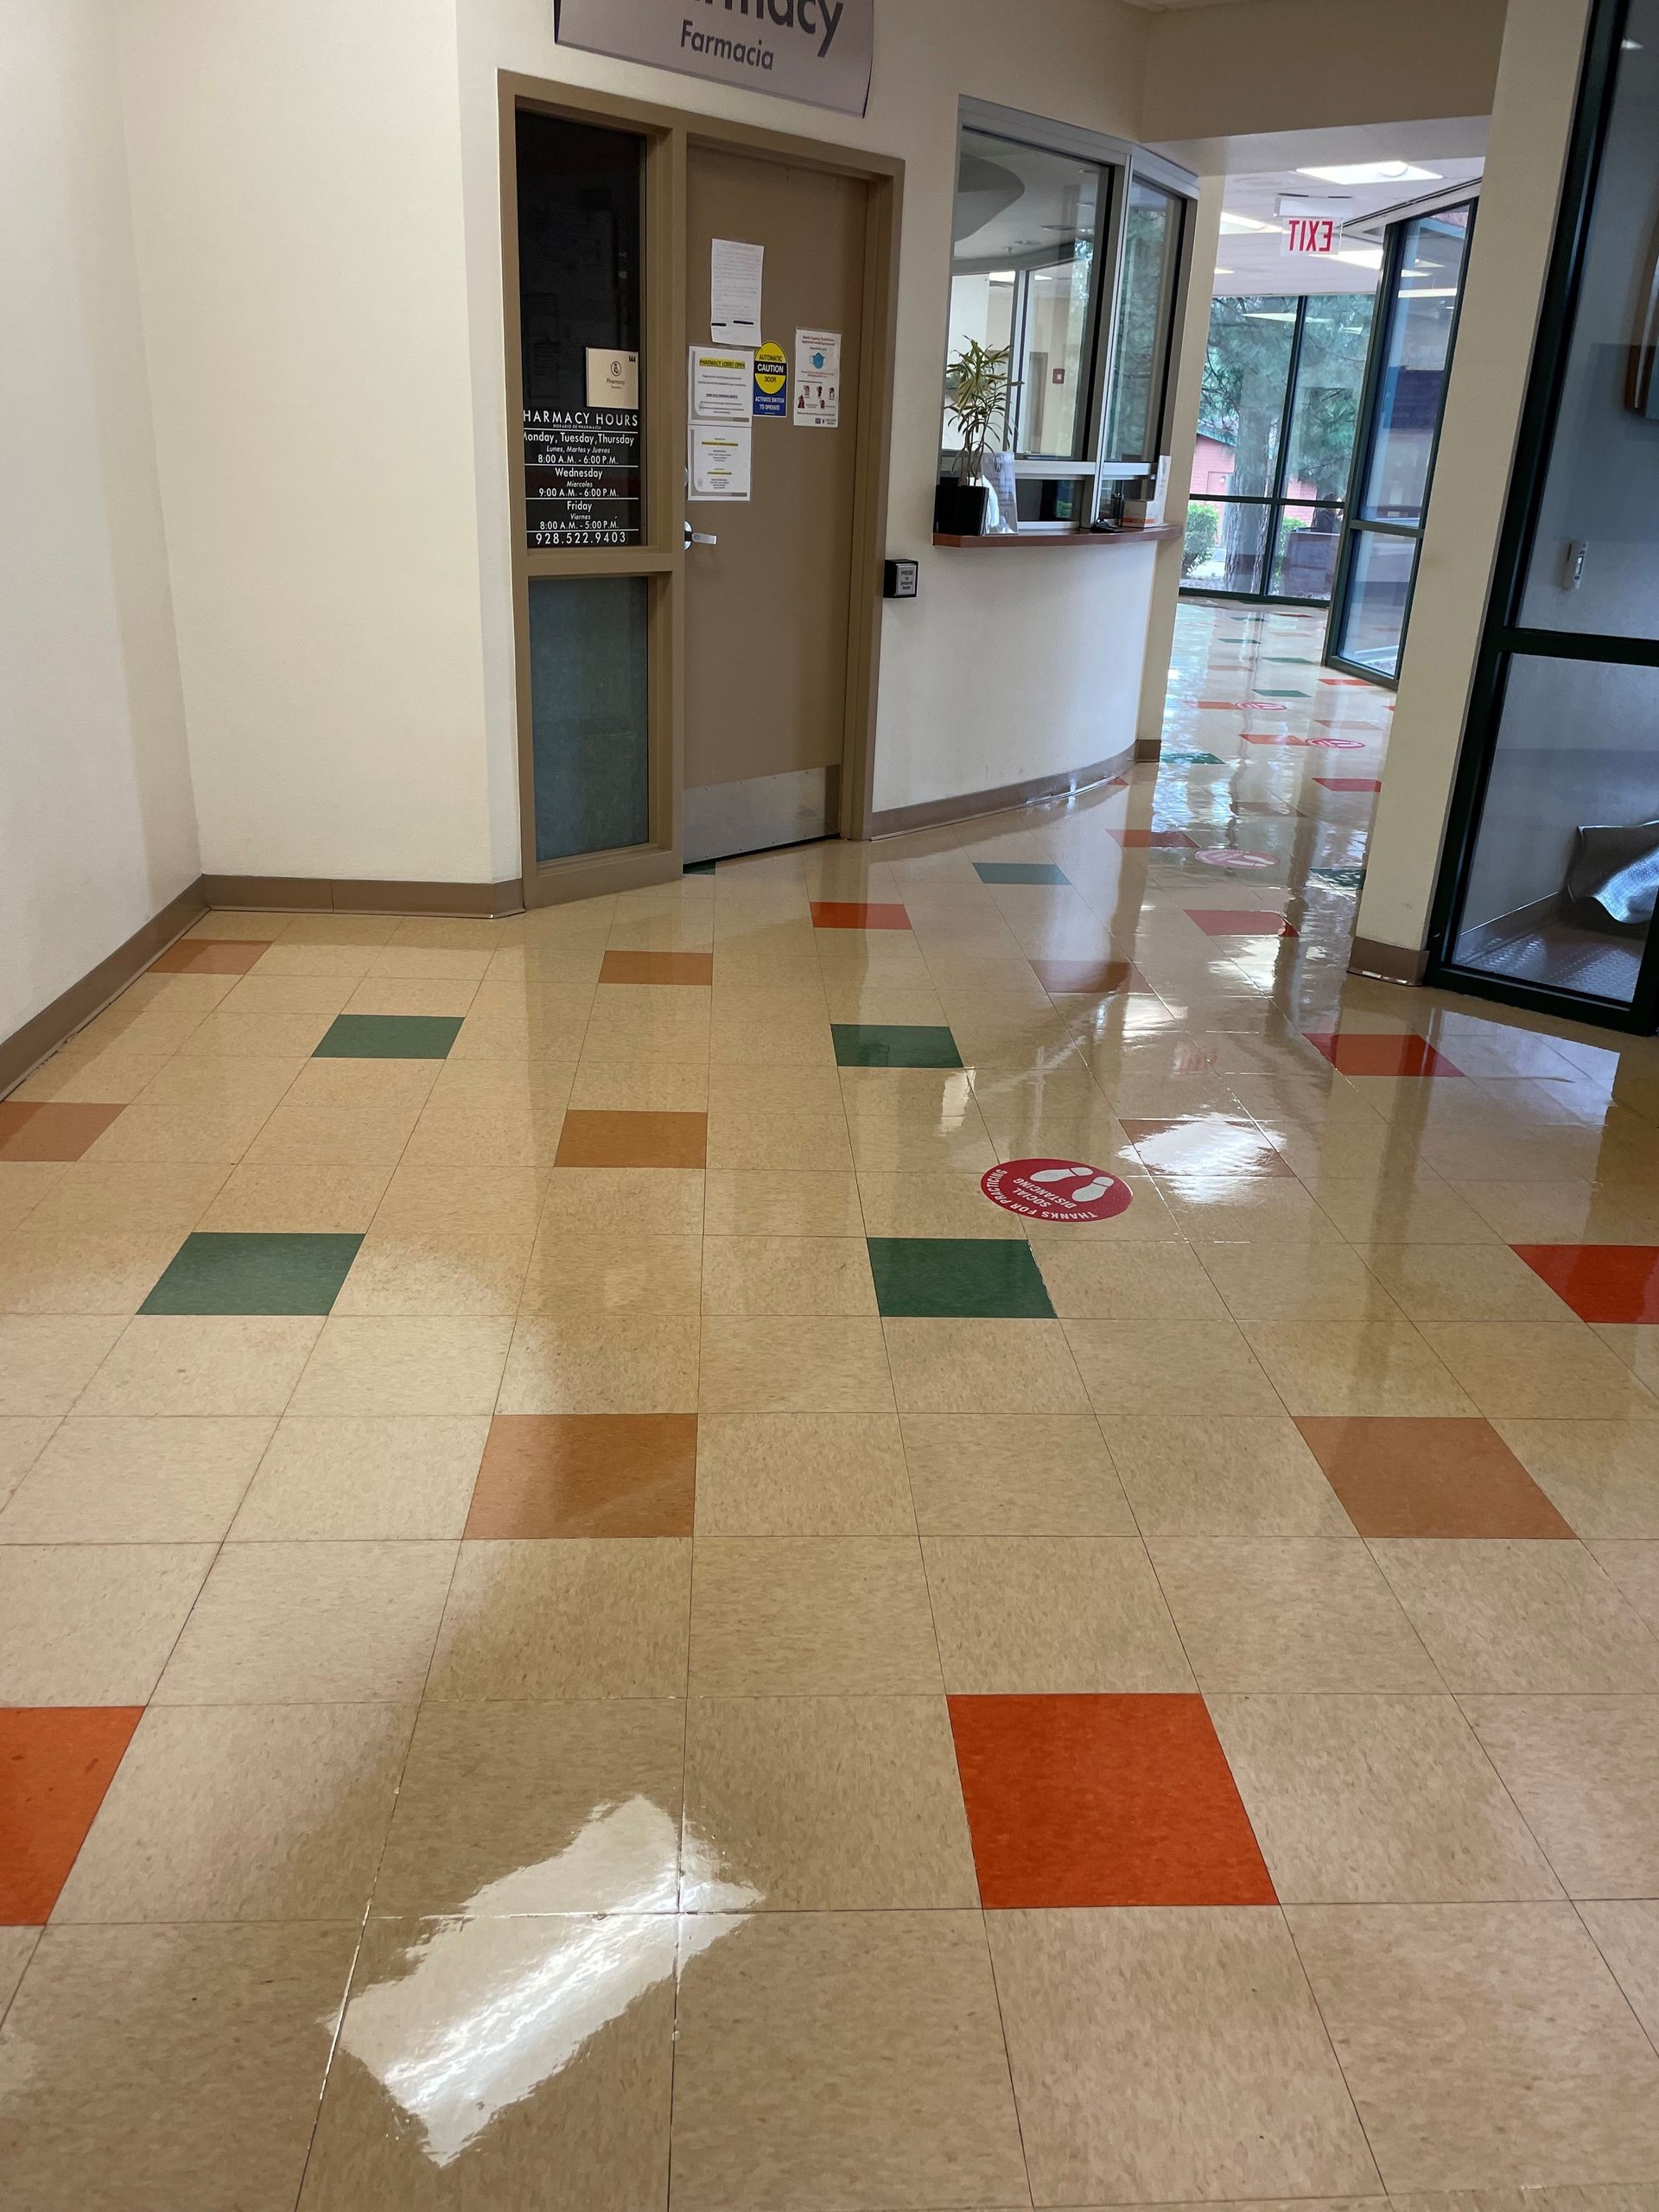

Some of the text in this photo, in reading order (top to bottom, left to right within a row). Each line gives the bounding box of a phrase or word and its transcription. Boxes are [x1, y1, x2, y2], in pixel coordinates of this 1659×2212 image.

[680, 19, 775, 71] Farmacia
[757, 363, 784, 373] CAUTION
[523, 410, 638, 427] HARMACY HOURS
[598, 434, 634, 447] Thursday
[537, 454, 556, 464] 8:00
[558, 455, 577, 464] A.M.
[583, 455, 601, 465] 6:00
[602, 456, 619, 465] P.M.
[555, 467, 603, 480] Wednesday
[538, 488, 557, 497] 9:00
[559, 488, 577, 497] A.M.
[584, 488, 601, 497] 6:00
[602, 488, 620, 497] P.M.
[567, 500, 593, 512] Friday
[540, 521, 558, 530] 8:00
[560, 521, 578, 530] A.M.
[585, 521, 602, 530] 5:00
[536, 531, 626, 545] 928.522.9403
[986, 1169, 1098, 1220] THANKS FOR PRACTICING
[1012, 1187, 1052, 1208] SOCIAL
[1014, 1178, 1077, 1210] DISTANCING
